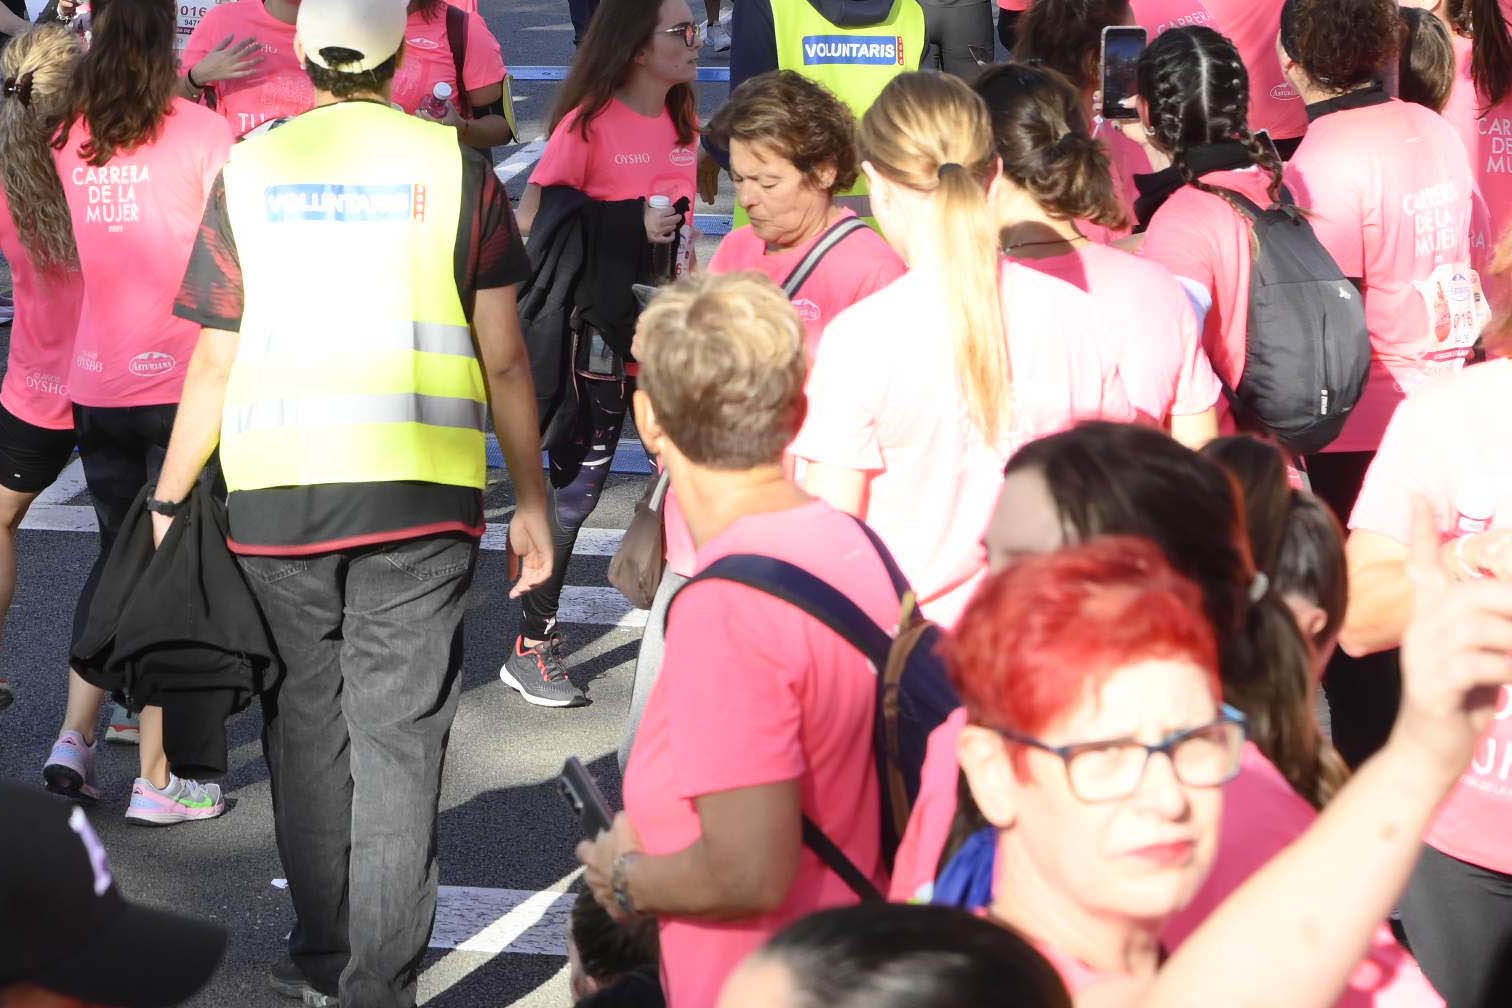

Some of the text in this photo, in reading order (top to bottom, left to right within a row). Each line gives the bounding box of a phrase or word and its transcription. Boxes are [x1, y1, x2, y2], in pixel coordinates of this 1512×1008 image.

[805, 43, 895, 58] VOLUNTARIS
[614, 153, 650, 165] OYSHO
[72, 165, 153, 186] CARRERA
[89, 185, 137, 203] DE LA
[85, 203, 139, 224] MUJER
